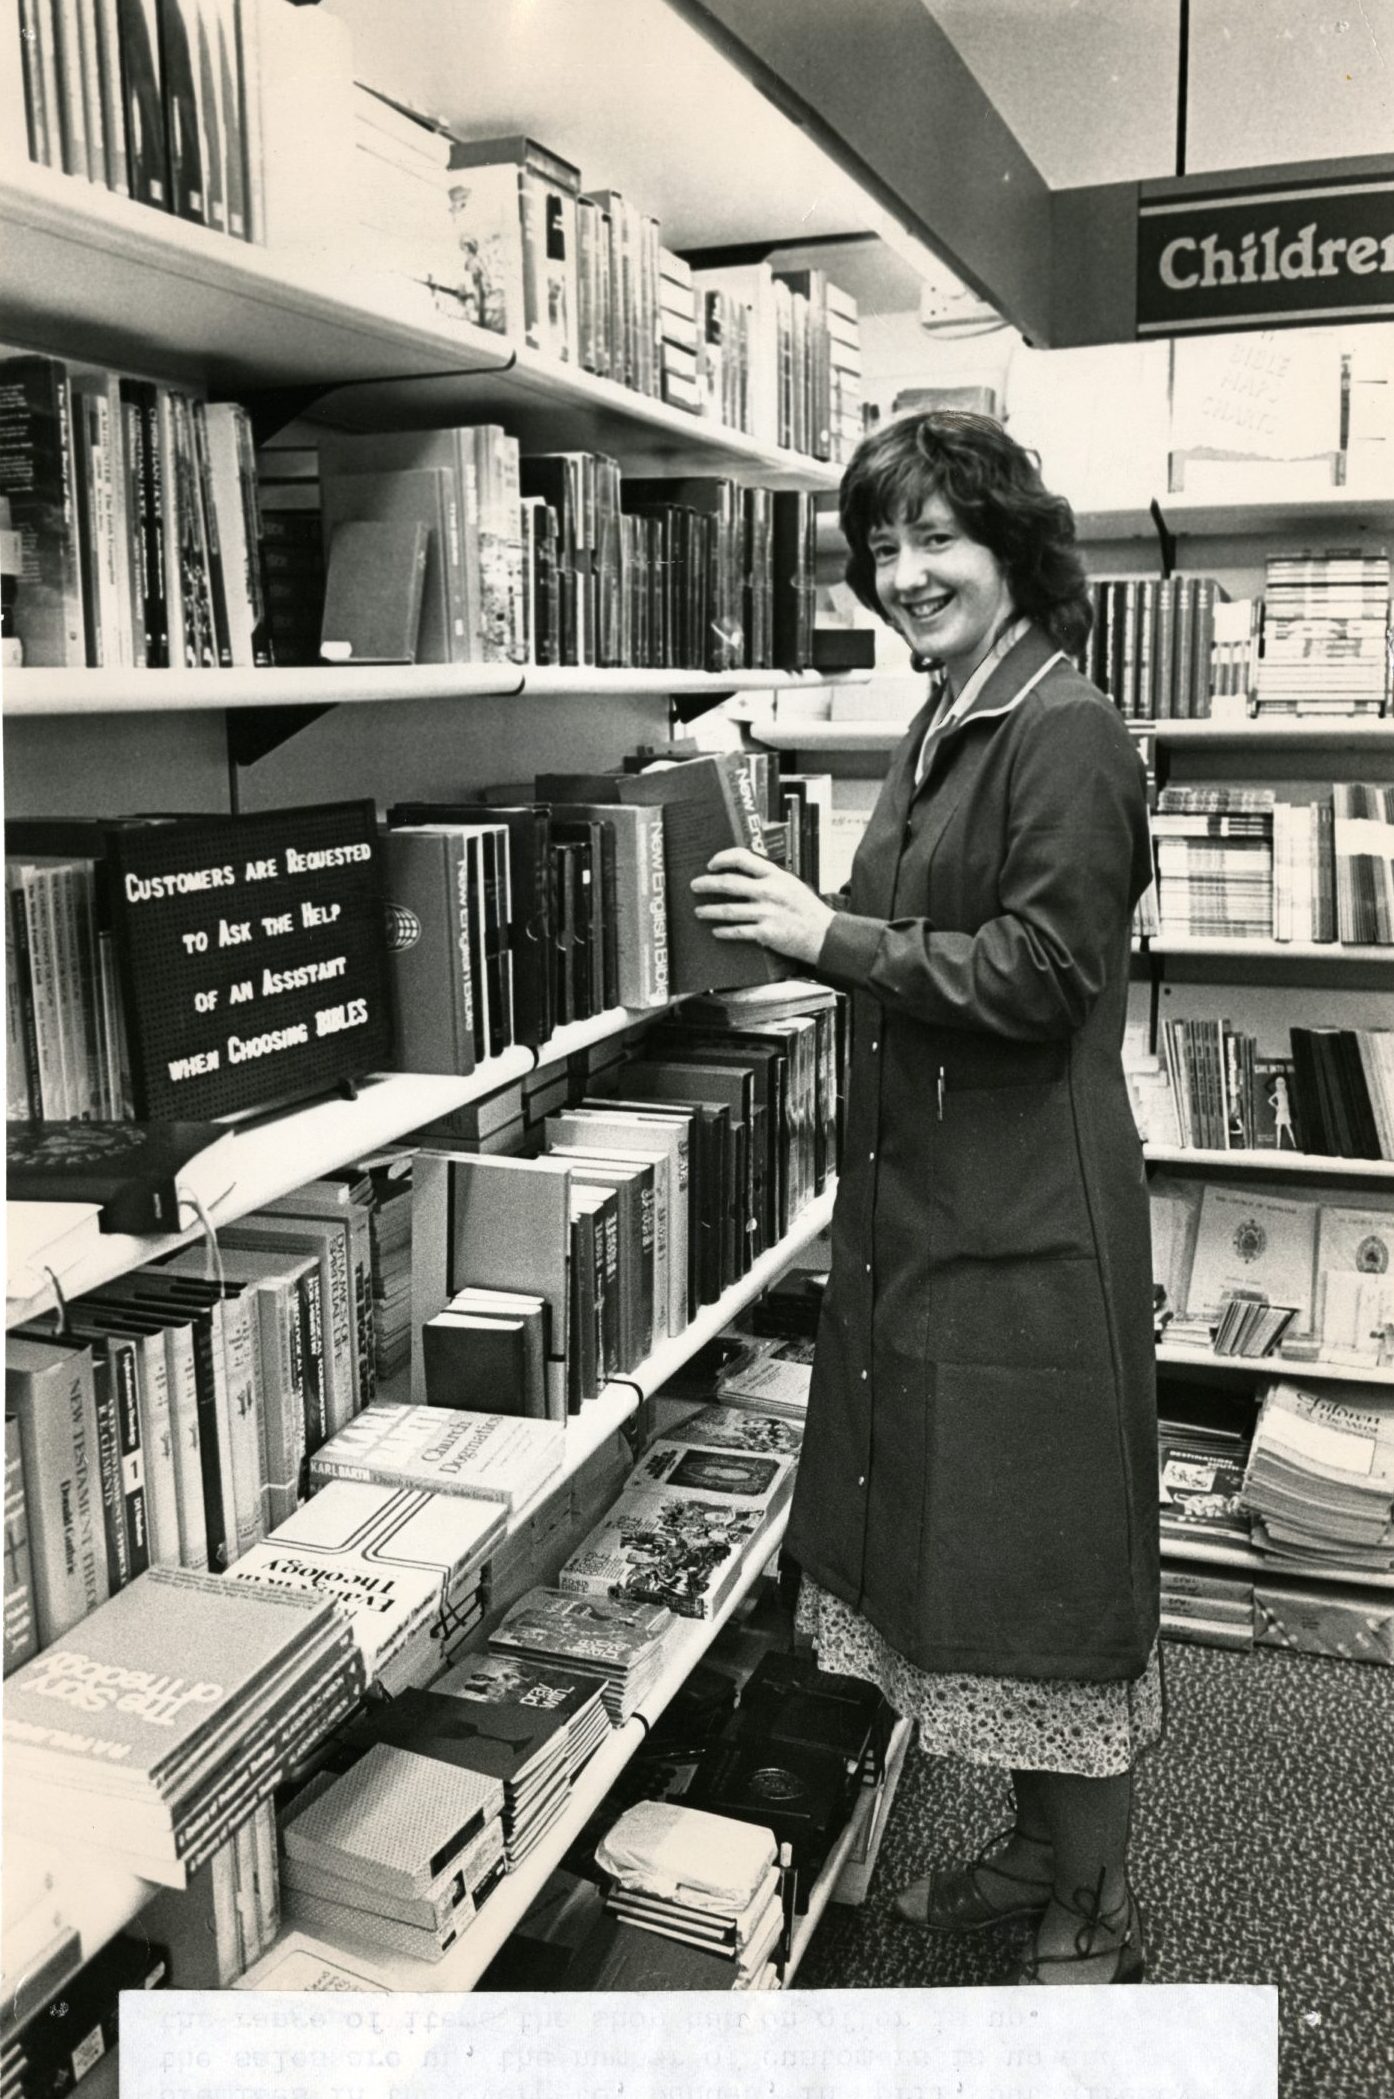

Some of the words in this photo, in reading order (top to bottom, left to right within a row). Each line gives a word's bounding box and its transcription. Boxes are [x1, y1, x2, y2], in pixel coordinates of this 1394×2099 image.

[735, 768, 755, 812] New
[650, 821, 664, 870] New
[126, 863, 235, 902] CUSTOMERS
[246, 857, 278, 882] ARE
[286, 842, 371, 875] REQUESTED
[456, 858, 467, 905] New
[183, 930, 208, 954] TO
[218, 919, 252, 948] ASK
[262, 914, 293, 937] THE
[302, 901, 341, 928] HELP
[648, 872, 666, 947] English
[194, 989, 218, 1013] OF
[230, 982, 254, 1006] AN
[262, 955, 347, 996] ASSISTANT
[168, 1053, 220, 1082] WHEN
[228, 1022, 309, 1063] CHOOSING
[315, 998, 368, 1038] BIBLES
[69, 1378, 83, 1423] NEW
[421, 1419, 474, 1462] Church
[438, 1414, 505, 1475] Dogmatics
[72, 1429, 91, 1546] TESTAMENT
[130, 1460, 138, 1478] 1
[310, 1461, 339, 1475] KARL
[260, 1558, 397, 1595] Theology
[124, 1697, 182, 1726] The
[519, 1682, 551, 1706] pray
